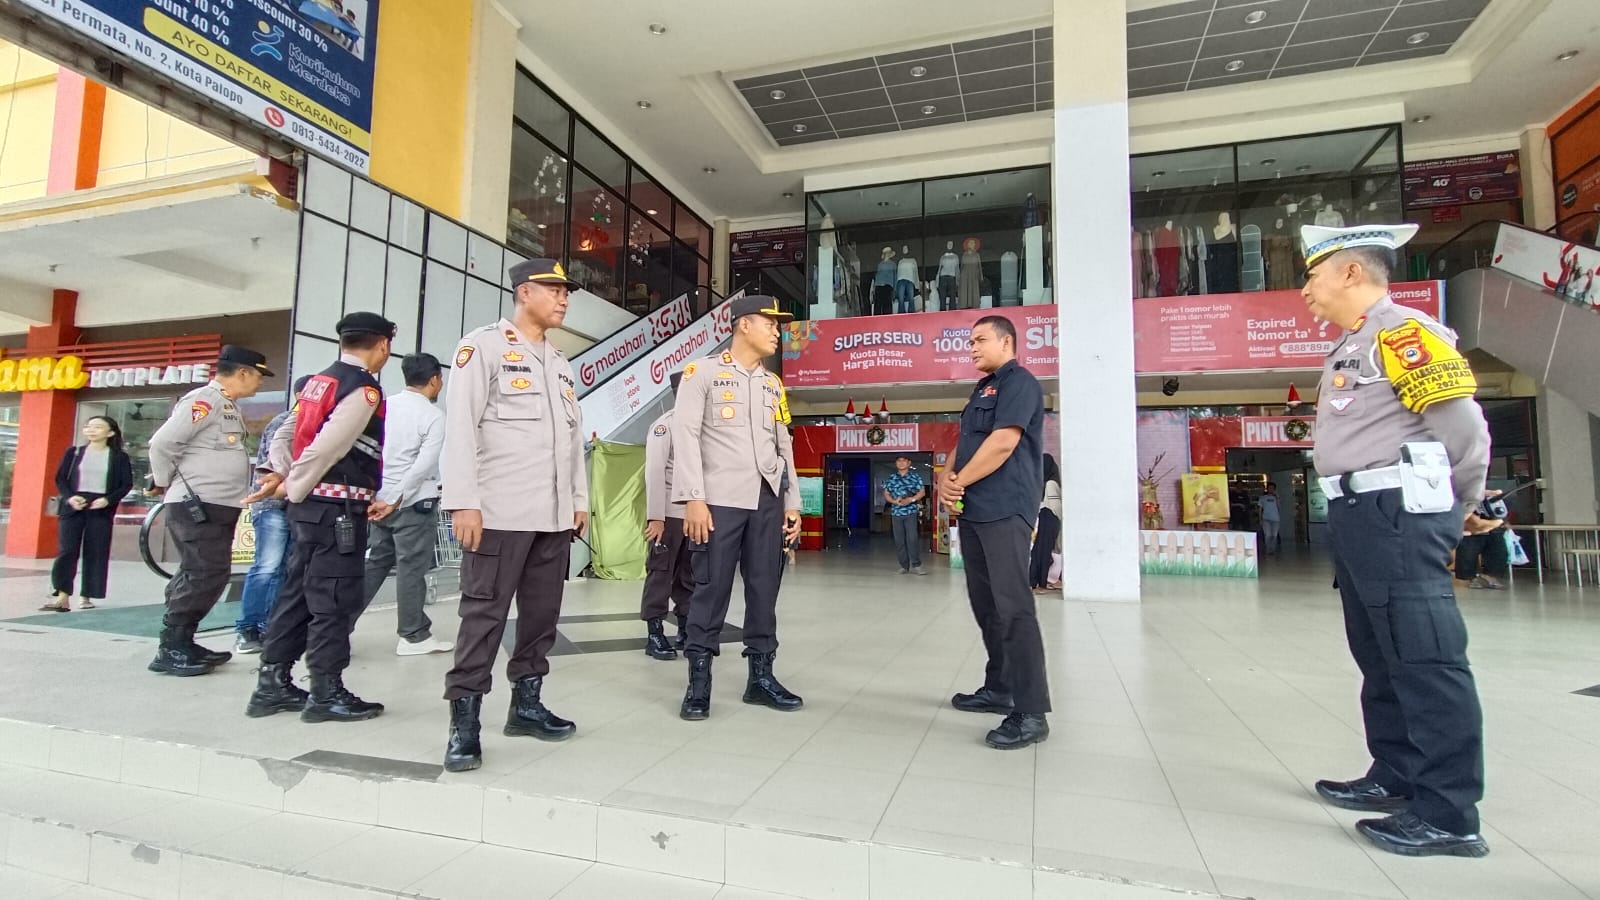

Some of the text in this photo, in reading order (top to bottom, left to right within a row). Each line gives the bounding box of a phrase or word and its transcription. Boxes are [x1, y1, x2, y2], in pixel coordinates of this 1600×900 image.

[211, 5, 230, 26] %
[191, 14, 209, 33] 40
[211, 24, 230, 46] %
[298, 24, 312, 42] 30
[313, 33, 328, 52] %
[62, 0, 243, 105] Permata, No. 2, Kota Palopo
[288, 42, 361, 98] Kurikulum
[172, 30, 352, 138] AYO DAFTAR SEKARANG!
[288, 58, 351, 107] Merdeka
[291, 121, 365, 169] 0813-5434-2022
[1161, 311, 1230, 322] praktis dan murah
[1184, 305, 1211, 313] nomor
[943, 329, 971, 338] Kuota
[1247, 317, 1296, 331] Expired
[1247, 330, 1292, 341] Nomor
[1294, 328, 1311, 339] ta'
[595, 328, 647, 375] matahari
[663, 324, 709, 373] matahari
[833, 331, 923, 352] SUPER SERU
[842, 358, 913, 371] Harga Hemat
[850, 348, 906, 361] Kuota Besar
[90, 363, 211, 388] HOTPLATE
[879, 428, 914, 448] ASUK
